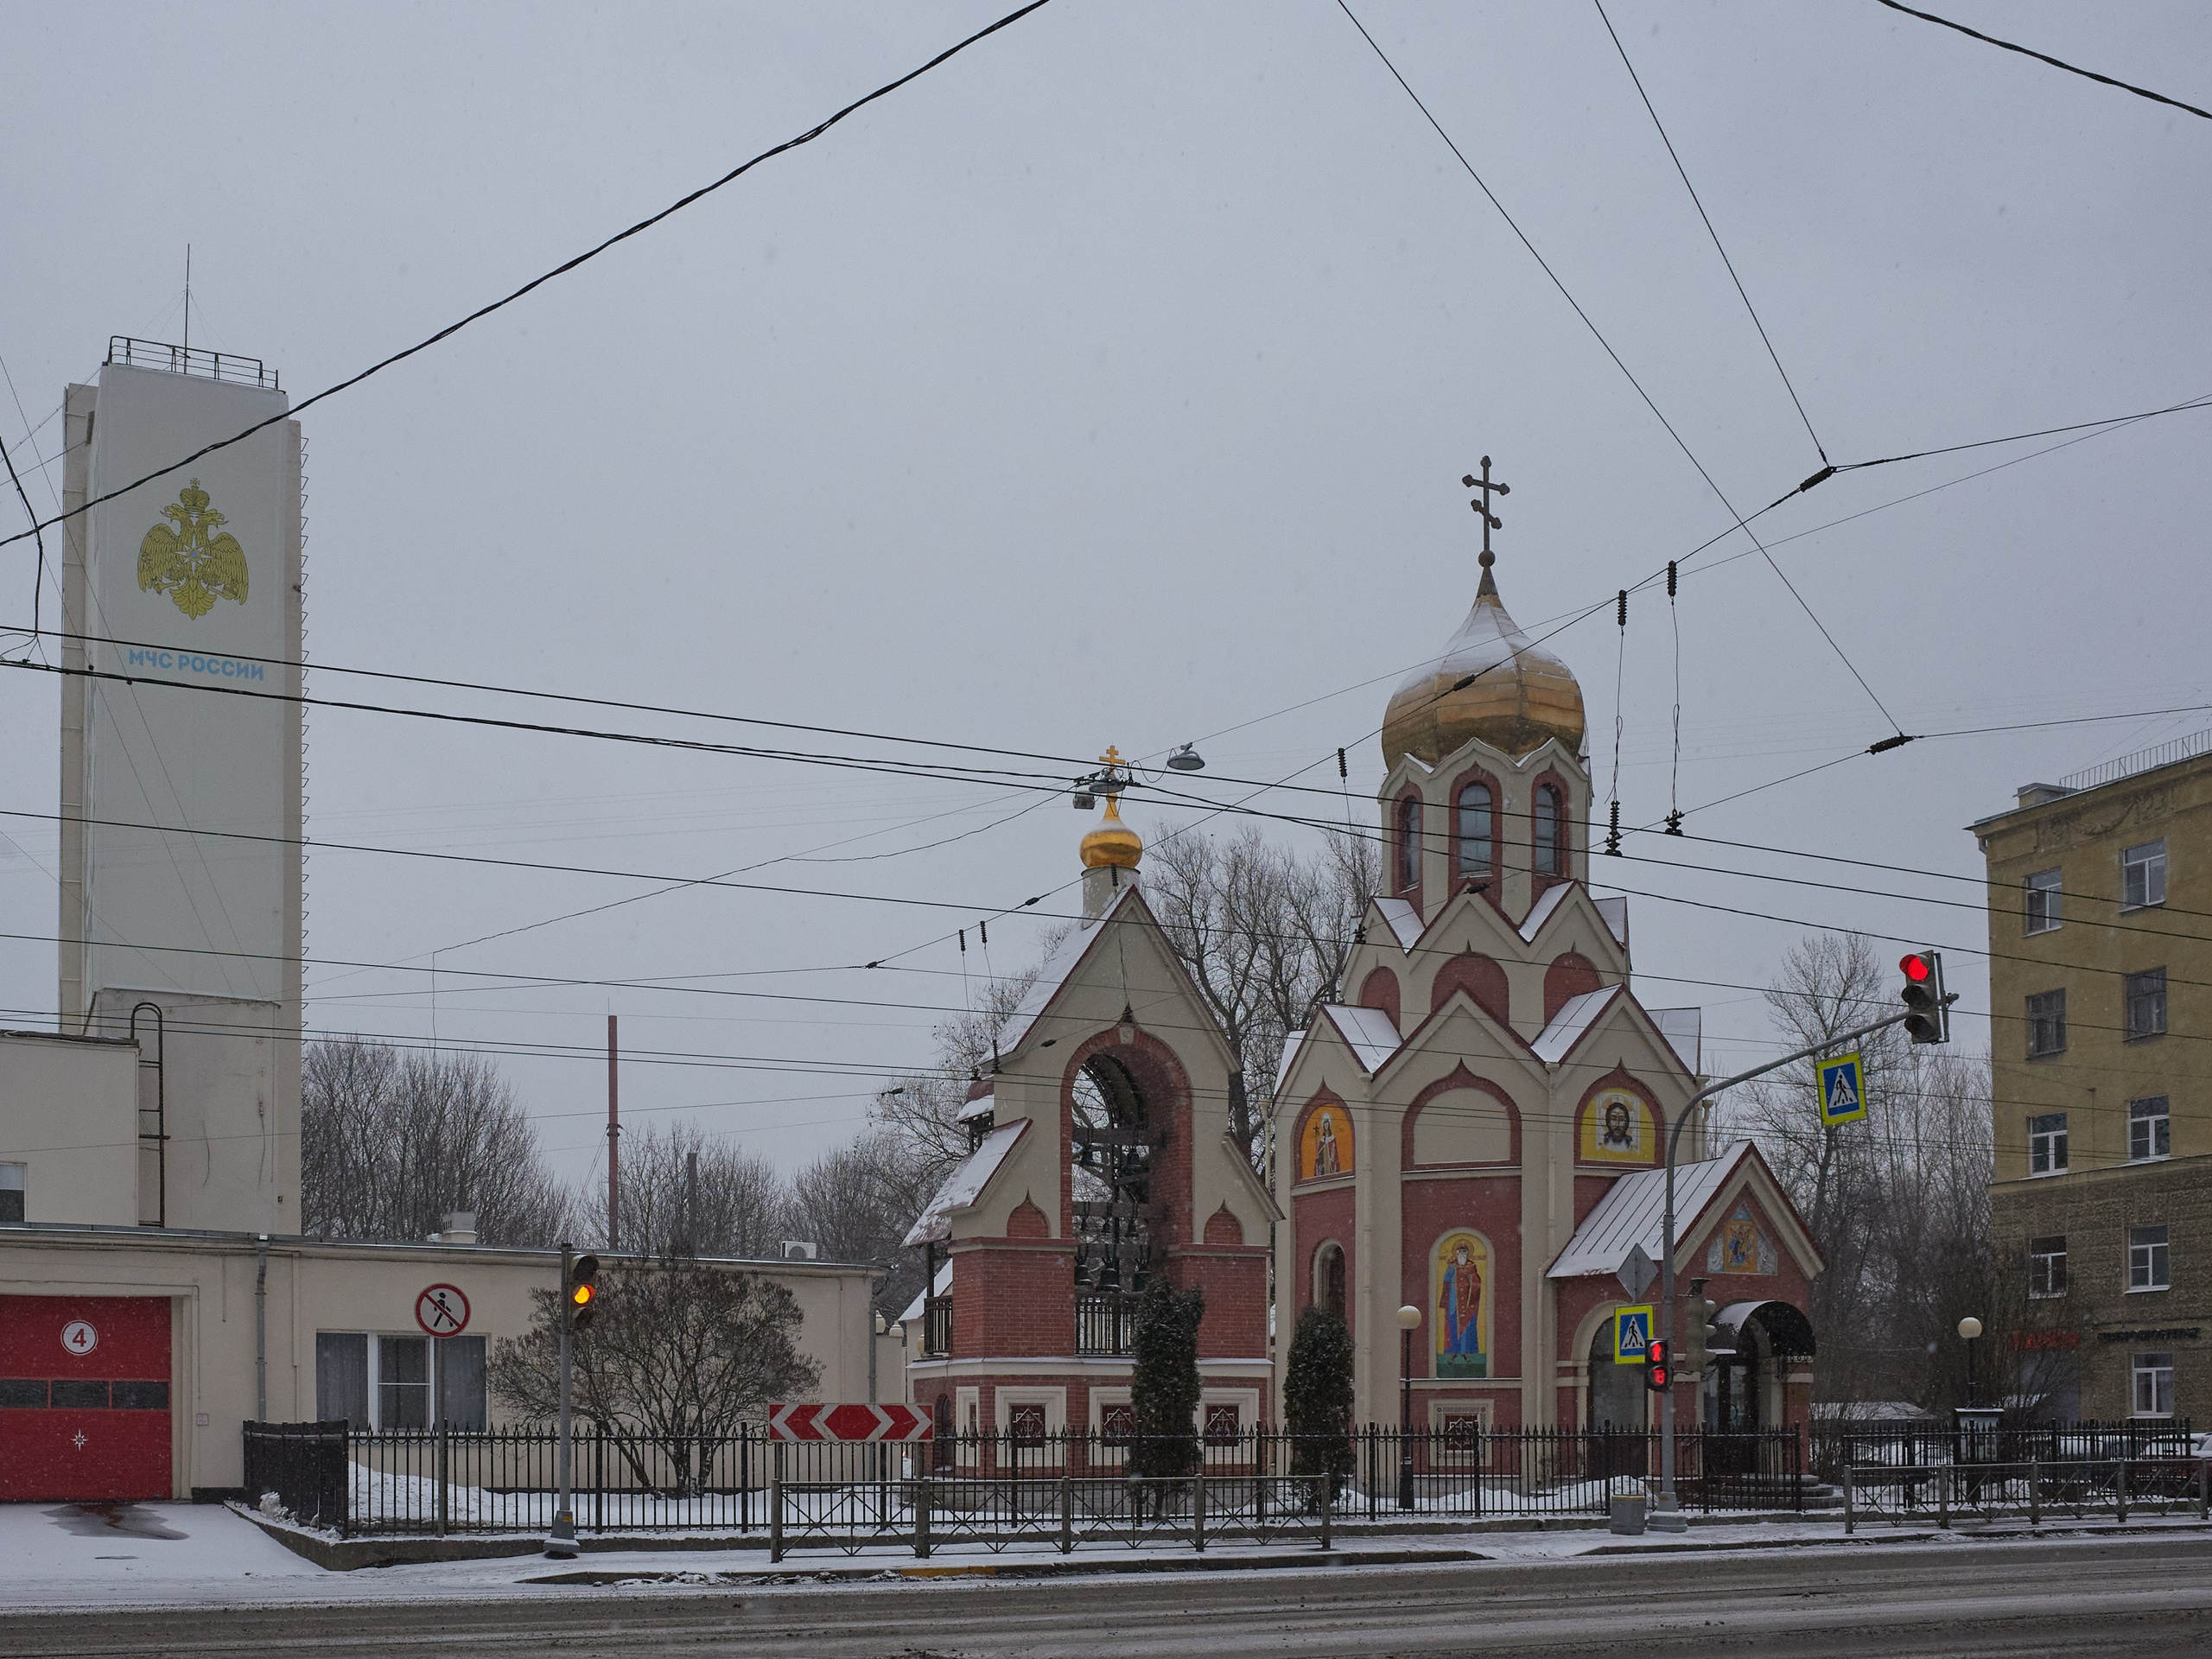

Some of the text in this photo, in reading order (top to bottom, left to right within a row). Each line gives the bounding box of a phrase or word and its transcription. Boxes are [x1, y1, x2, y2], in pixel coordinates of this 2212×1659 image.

[130, 650, 264, 680] МЧС РОССИИ
[73, 1328, 86, 1347] 4
